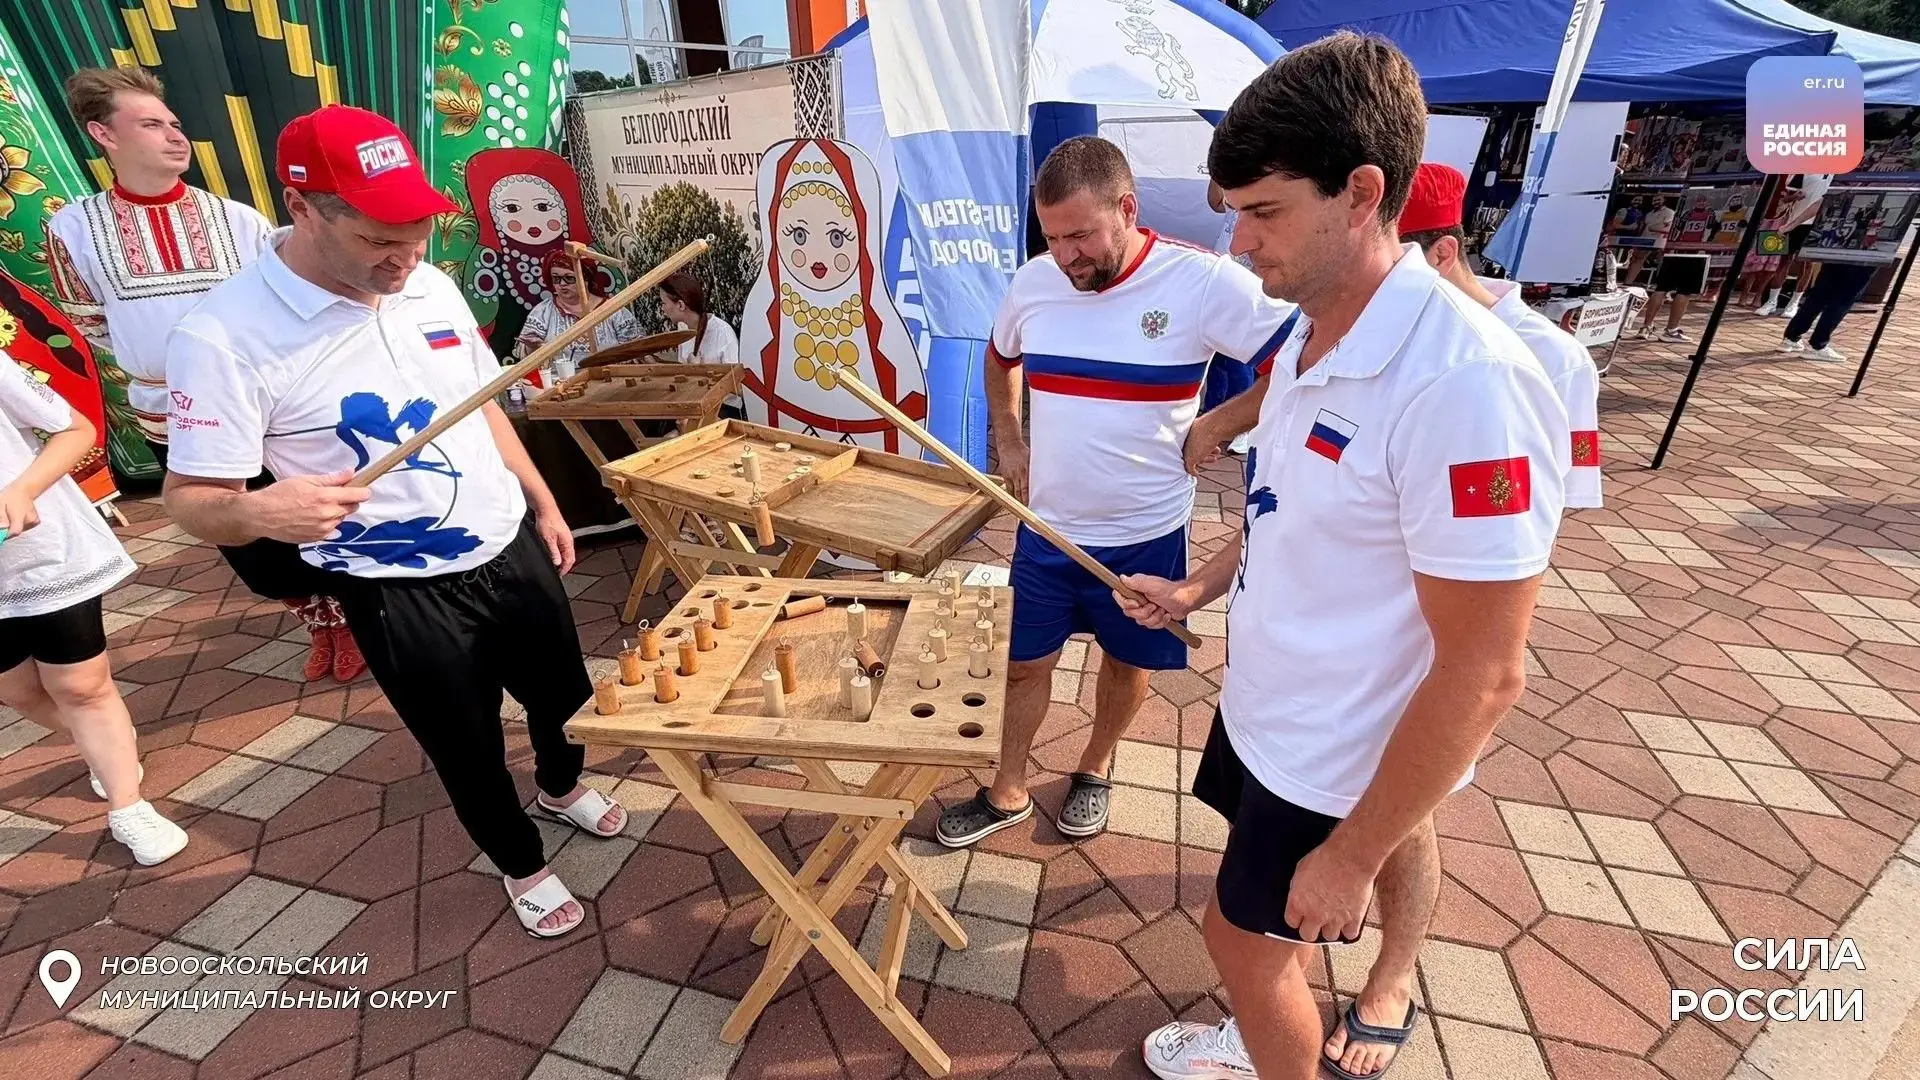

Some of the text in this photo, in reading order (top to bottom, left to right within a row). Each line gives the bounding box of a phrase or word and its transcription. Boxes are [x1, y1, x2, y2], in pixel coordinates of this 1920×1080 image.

[621, 95, 732, 148] БЕЛГОРОДСКИЙ
[611, 147, 718, 178] МУНИЦИПАЛЬНЫЙ
[1723, 222, 1736, 231] 15
[518, 897, 546, 915] SPORT
